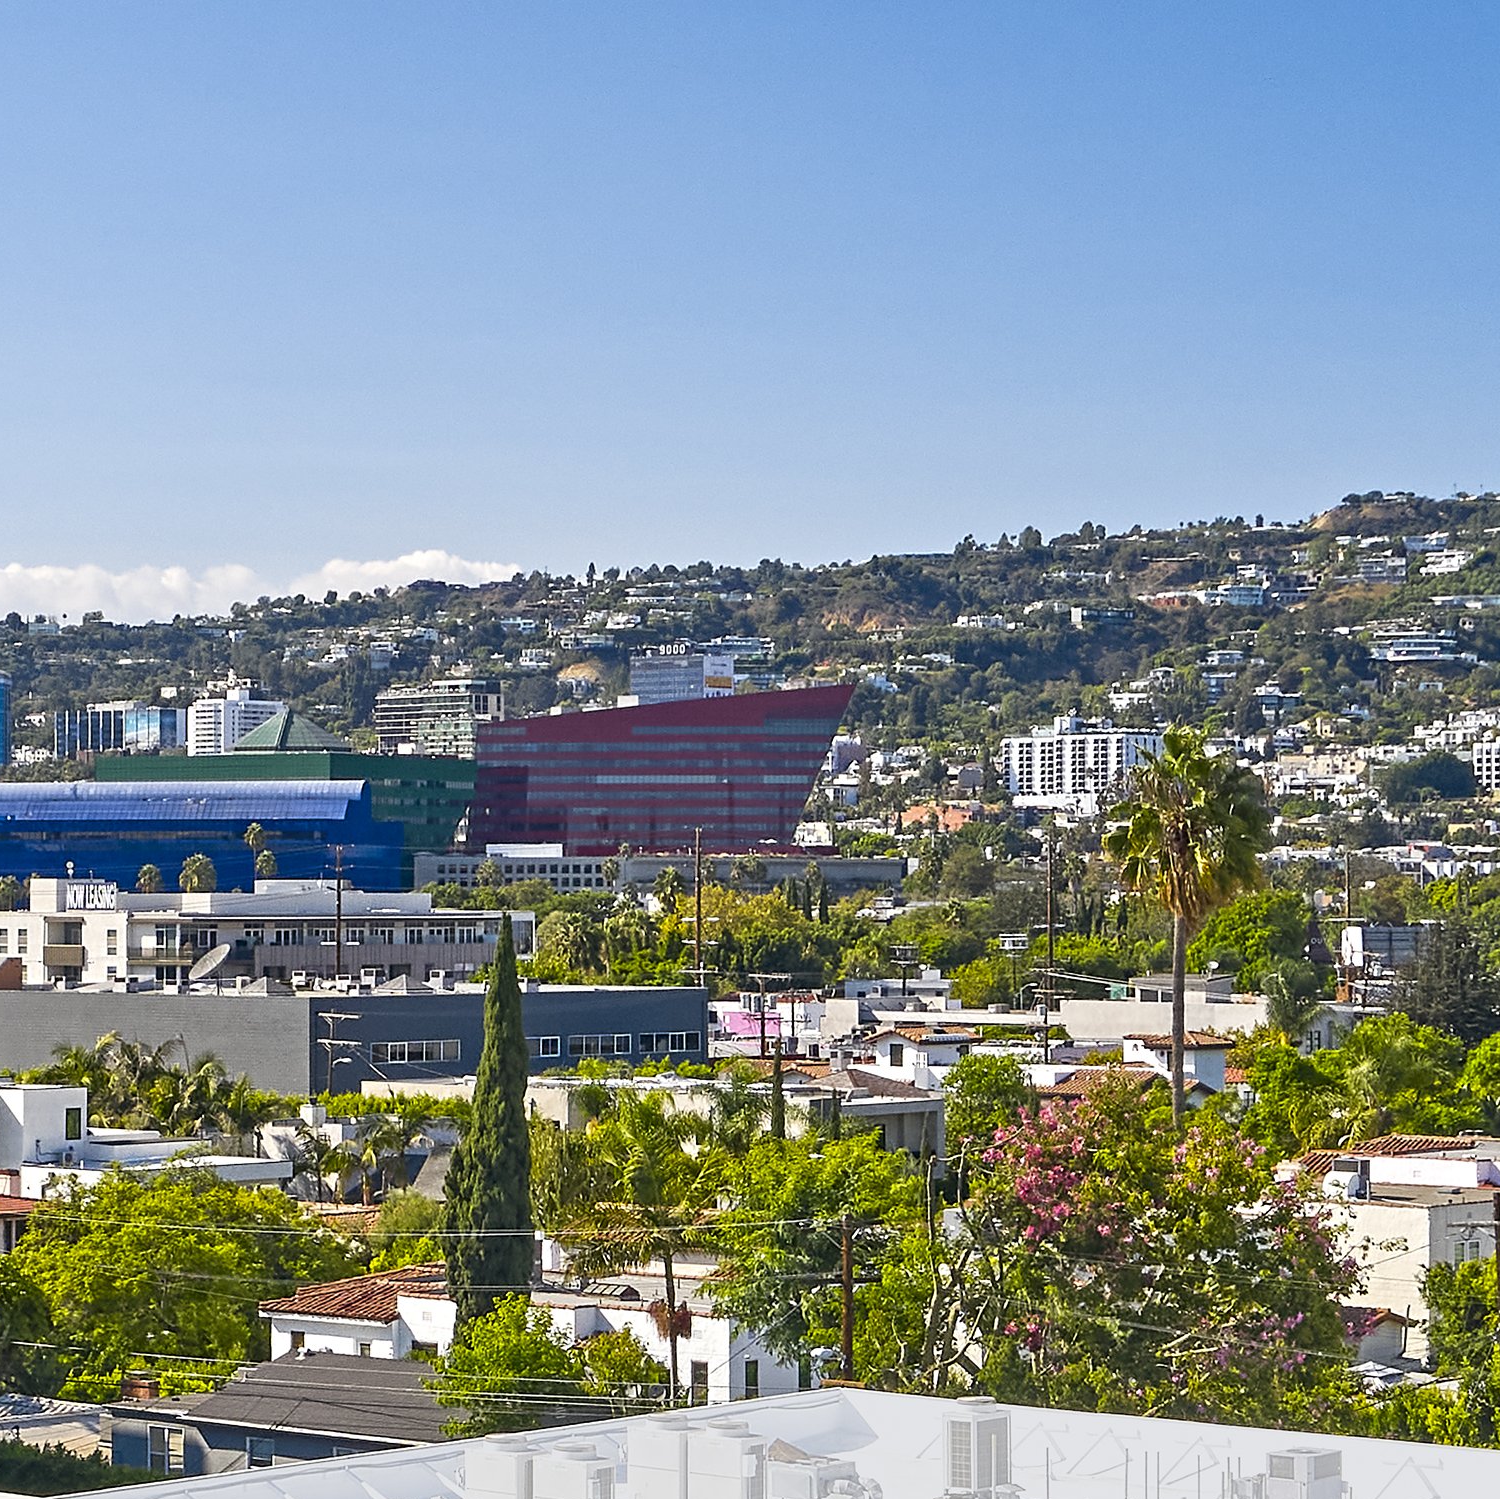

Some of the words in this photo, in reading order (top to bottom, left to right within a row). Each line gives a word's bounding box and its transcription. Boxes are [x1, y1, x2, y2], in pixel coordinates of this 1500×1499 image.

[659, 644, 686, 655] 9000
[67, 884, 84, 909] NOW
[85, 884, 115, 909] LEASING
